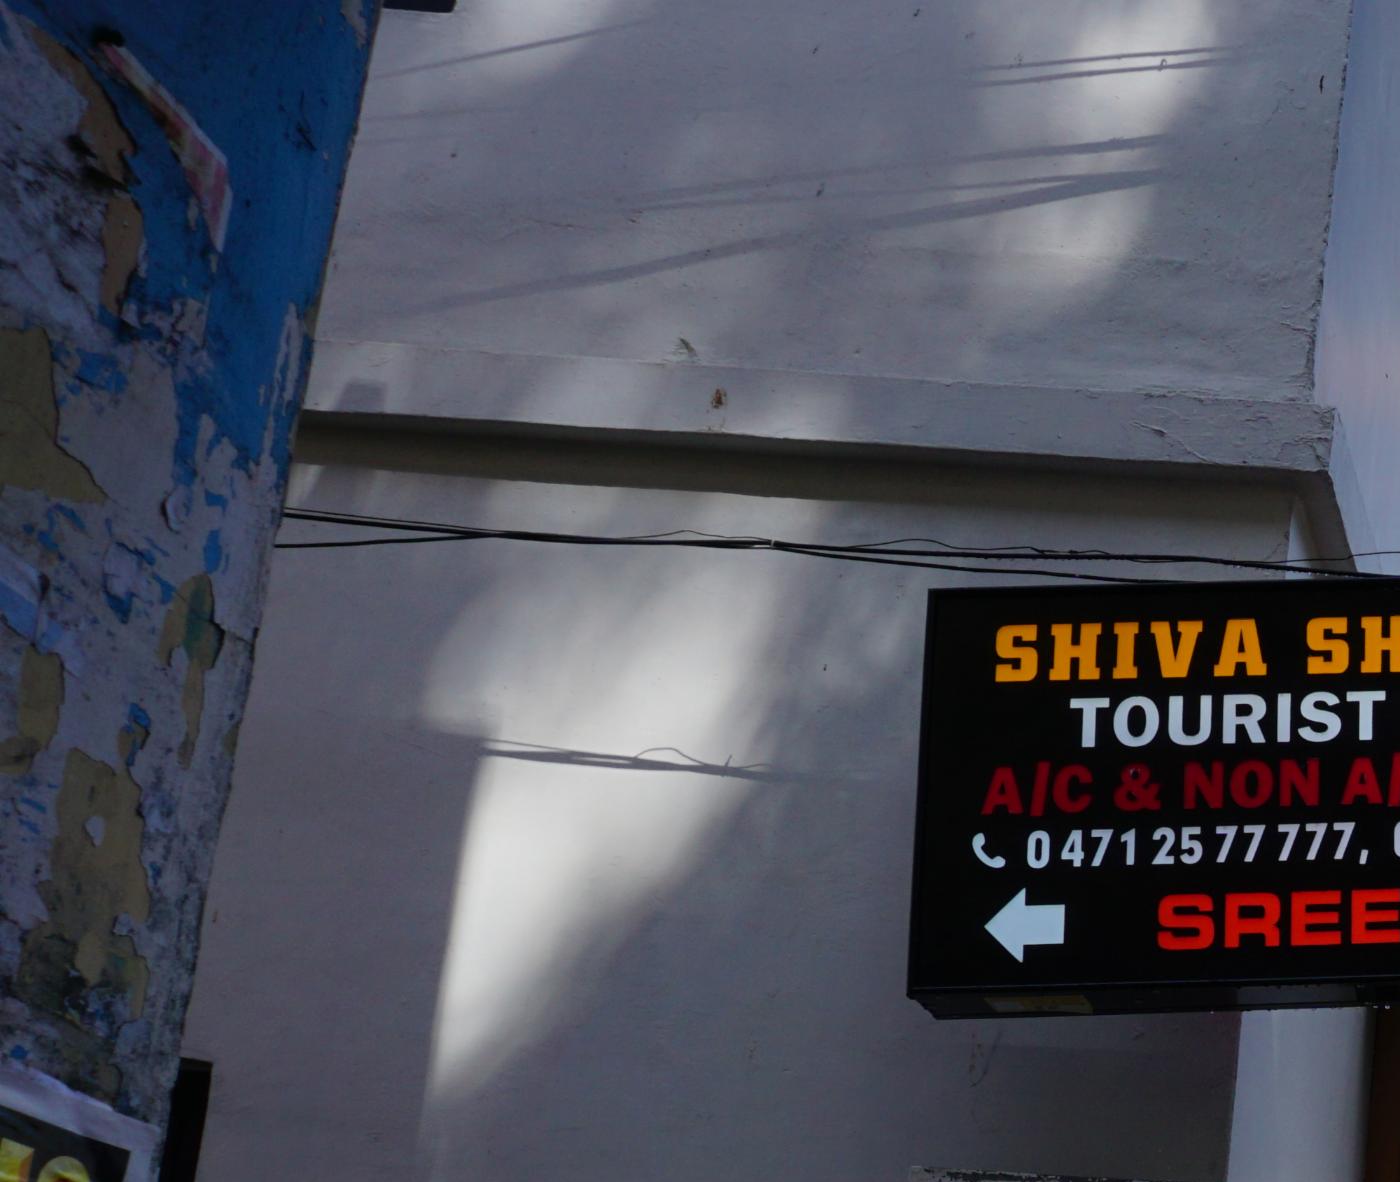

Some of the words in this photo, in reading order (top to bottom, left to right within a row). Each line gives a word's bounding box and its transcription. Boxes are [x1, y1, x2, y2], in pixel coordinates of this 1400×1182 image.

[995, 618, 1267, 682] SHIVA
[1069, 690, 1386, 748] TOURIST
[982, 761, 1092, 817] A/C
[1114, 764, 1161, 812] &
[1184, 759, 1320, 809] NON
